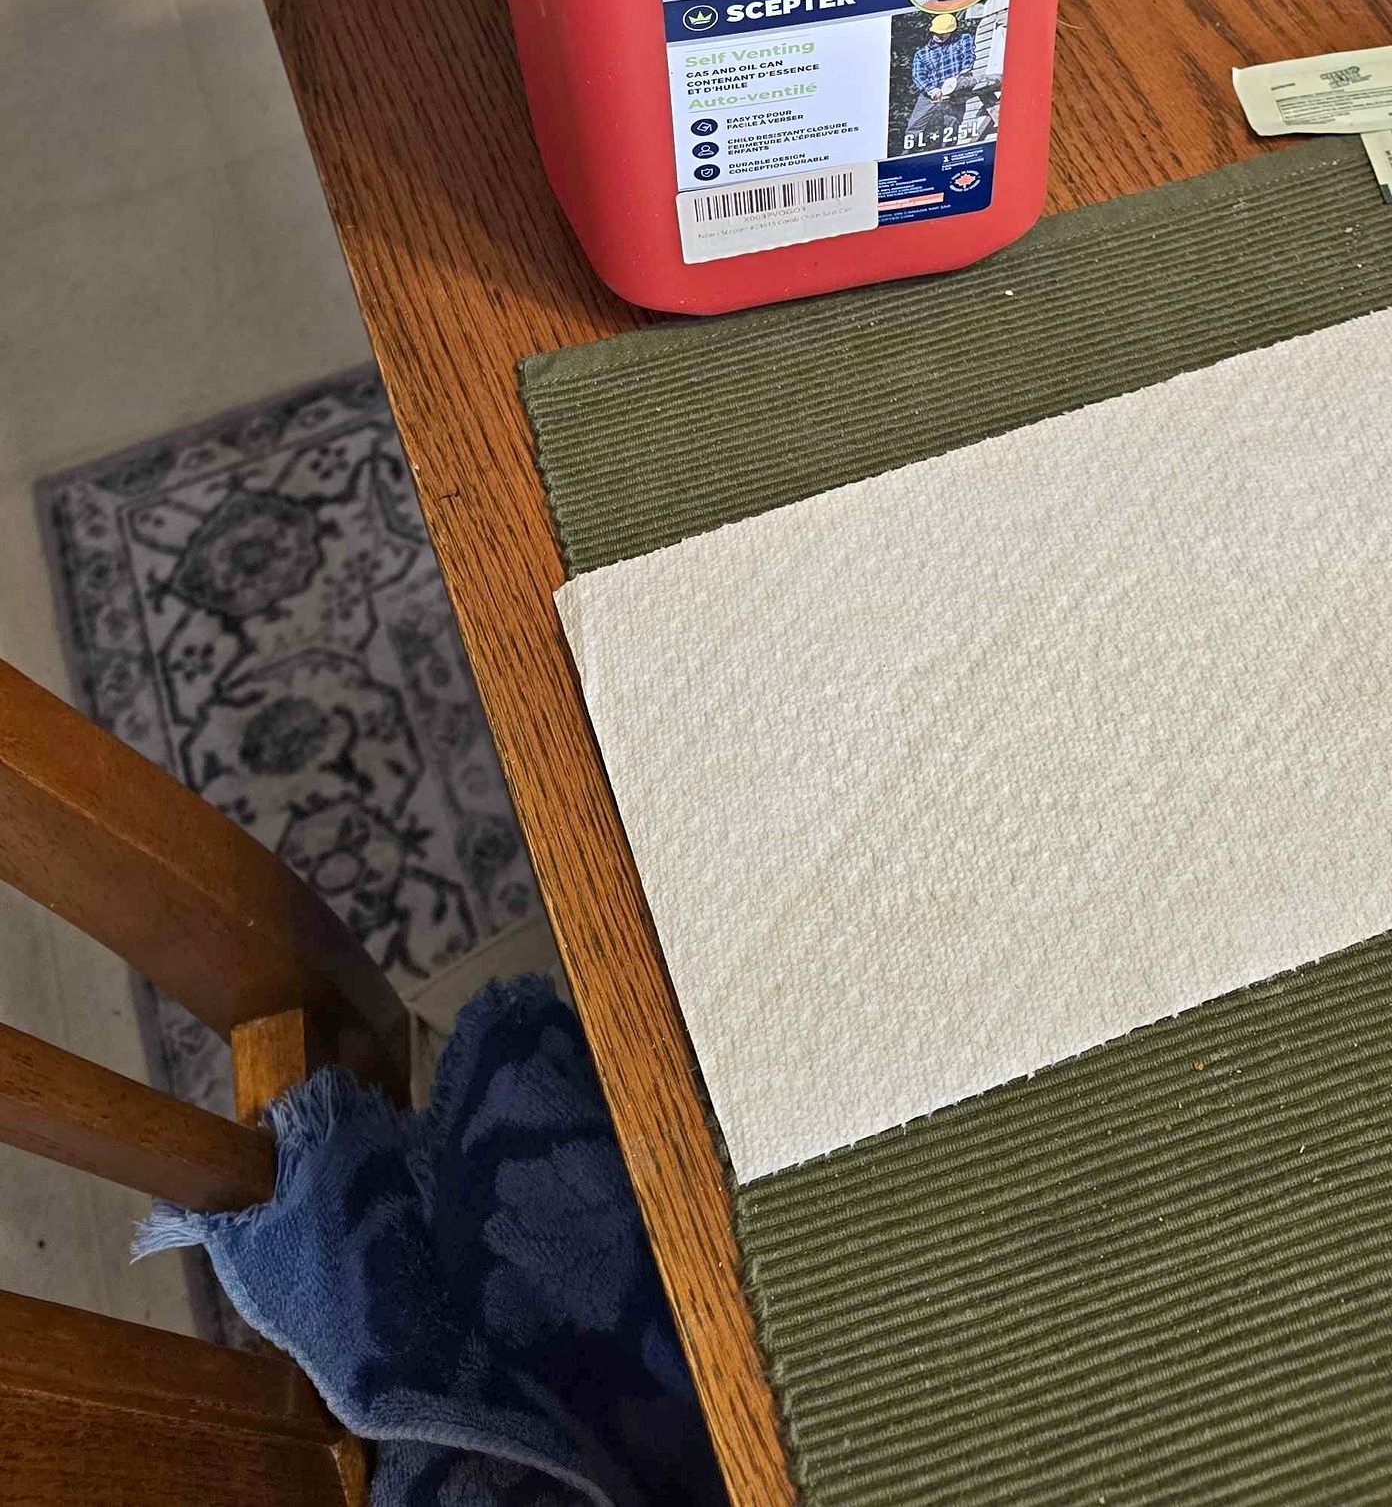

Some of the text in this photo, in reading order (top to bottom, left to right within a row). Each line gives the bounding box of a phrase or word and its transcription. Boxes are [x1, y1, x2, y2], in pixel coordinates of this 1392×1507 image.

[685, 41, 815, 68] Self Venting
[686, 60, 783, 78] GAS AND OIL CAN
[687, 64, 820, 87] CONTENANT D'ESSENCE
[689, 82, 817, 109] Auto-ventilé
[704, 82, 748, 93] D'HUILE
[727, 116, 750, 124] EASY
[767, 110, 792, 118] POUR
[727, 121, 758, 129] FACILE
[768, 115, 804, 124] VERSER
[727, 122, 847, 144] CHILD RESISTANT CLOSURE
[728, 139, 782, 150] FERMETURE
[841, 126, 859, 134] DES
[904, 134, 914, 150] 6
[918, 132, 926, 147] L
[943, 124, 968, 143] 2.5
[728, 145, 769, 155] ENFANTS
[729, 153, 805, 169] DURABLE DESIGN
[729, 155, 829, 174] CONCEPTION DURABLE
